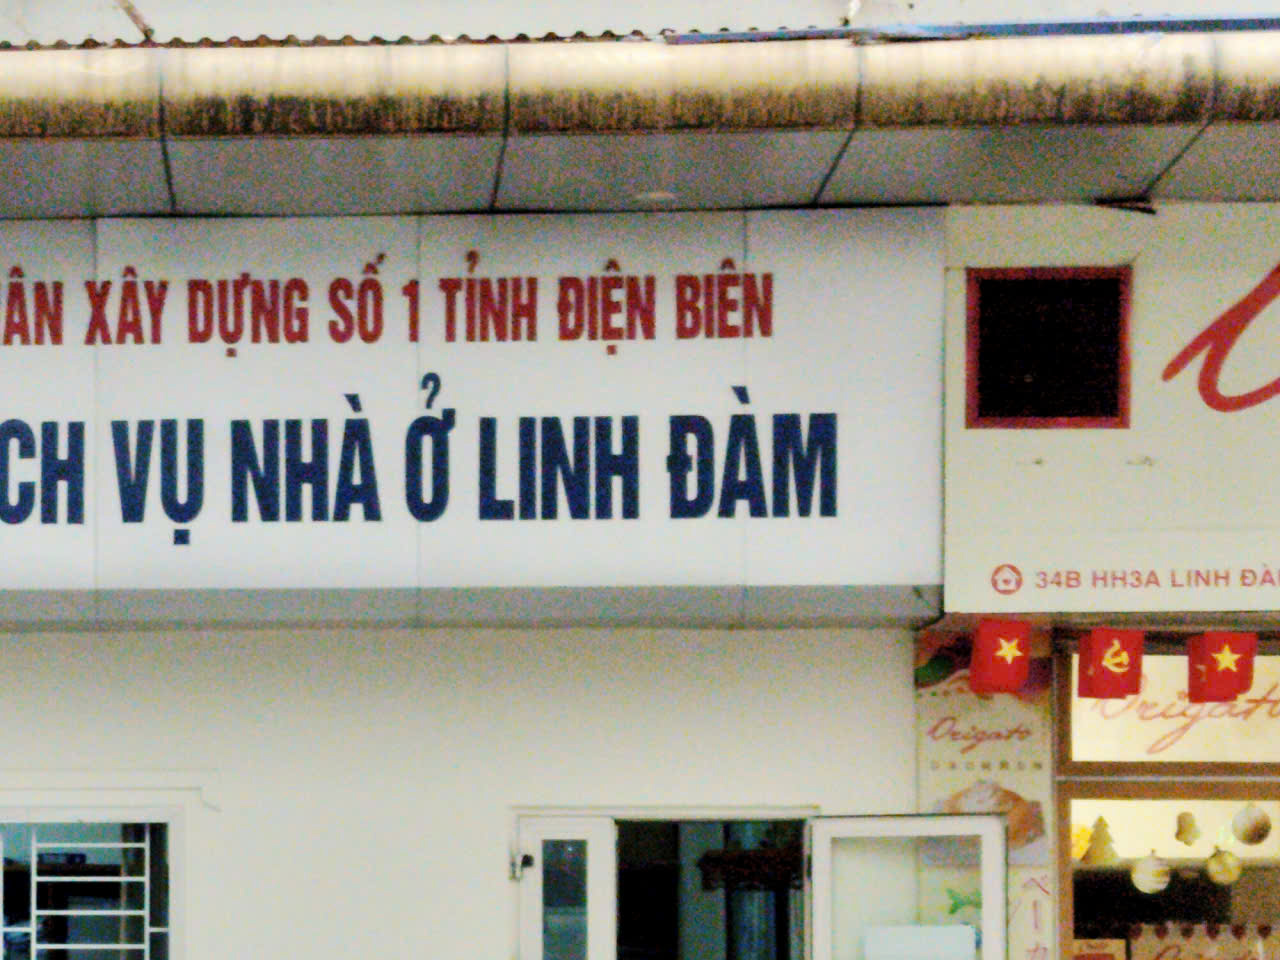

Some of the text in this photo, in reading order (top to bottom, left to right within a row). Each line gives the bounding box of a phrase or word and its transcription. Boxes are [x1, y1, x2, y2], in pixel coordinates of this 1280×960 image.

[85, 265, 169, 345] XÂY
[187, 272, 309, 358] DỰNG
[328, 252, 386, 344] SỐ
[402, 279, 420, 342] 1
[439, 250, 538, 342] TỈNH
[556, 258, 656, 355] ĐIỆN
[675, 257, 773, 339] BIÊN
[111, 418, 204, 545] VỤ
[230, 393, 382, 523] NHÀ
[405, 372, 456, 523] Ở
[478, 415, 640, 521] LINH
[666, 386, 838, 519] ĐÀM
[1035, 562, 1280, 589] 34B HH3A LINH ĐÀ
